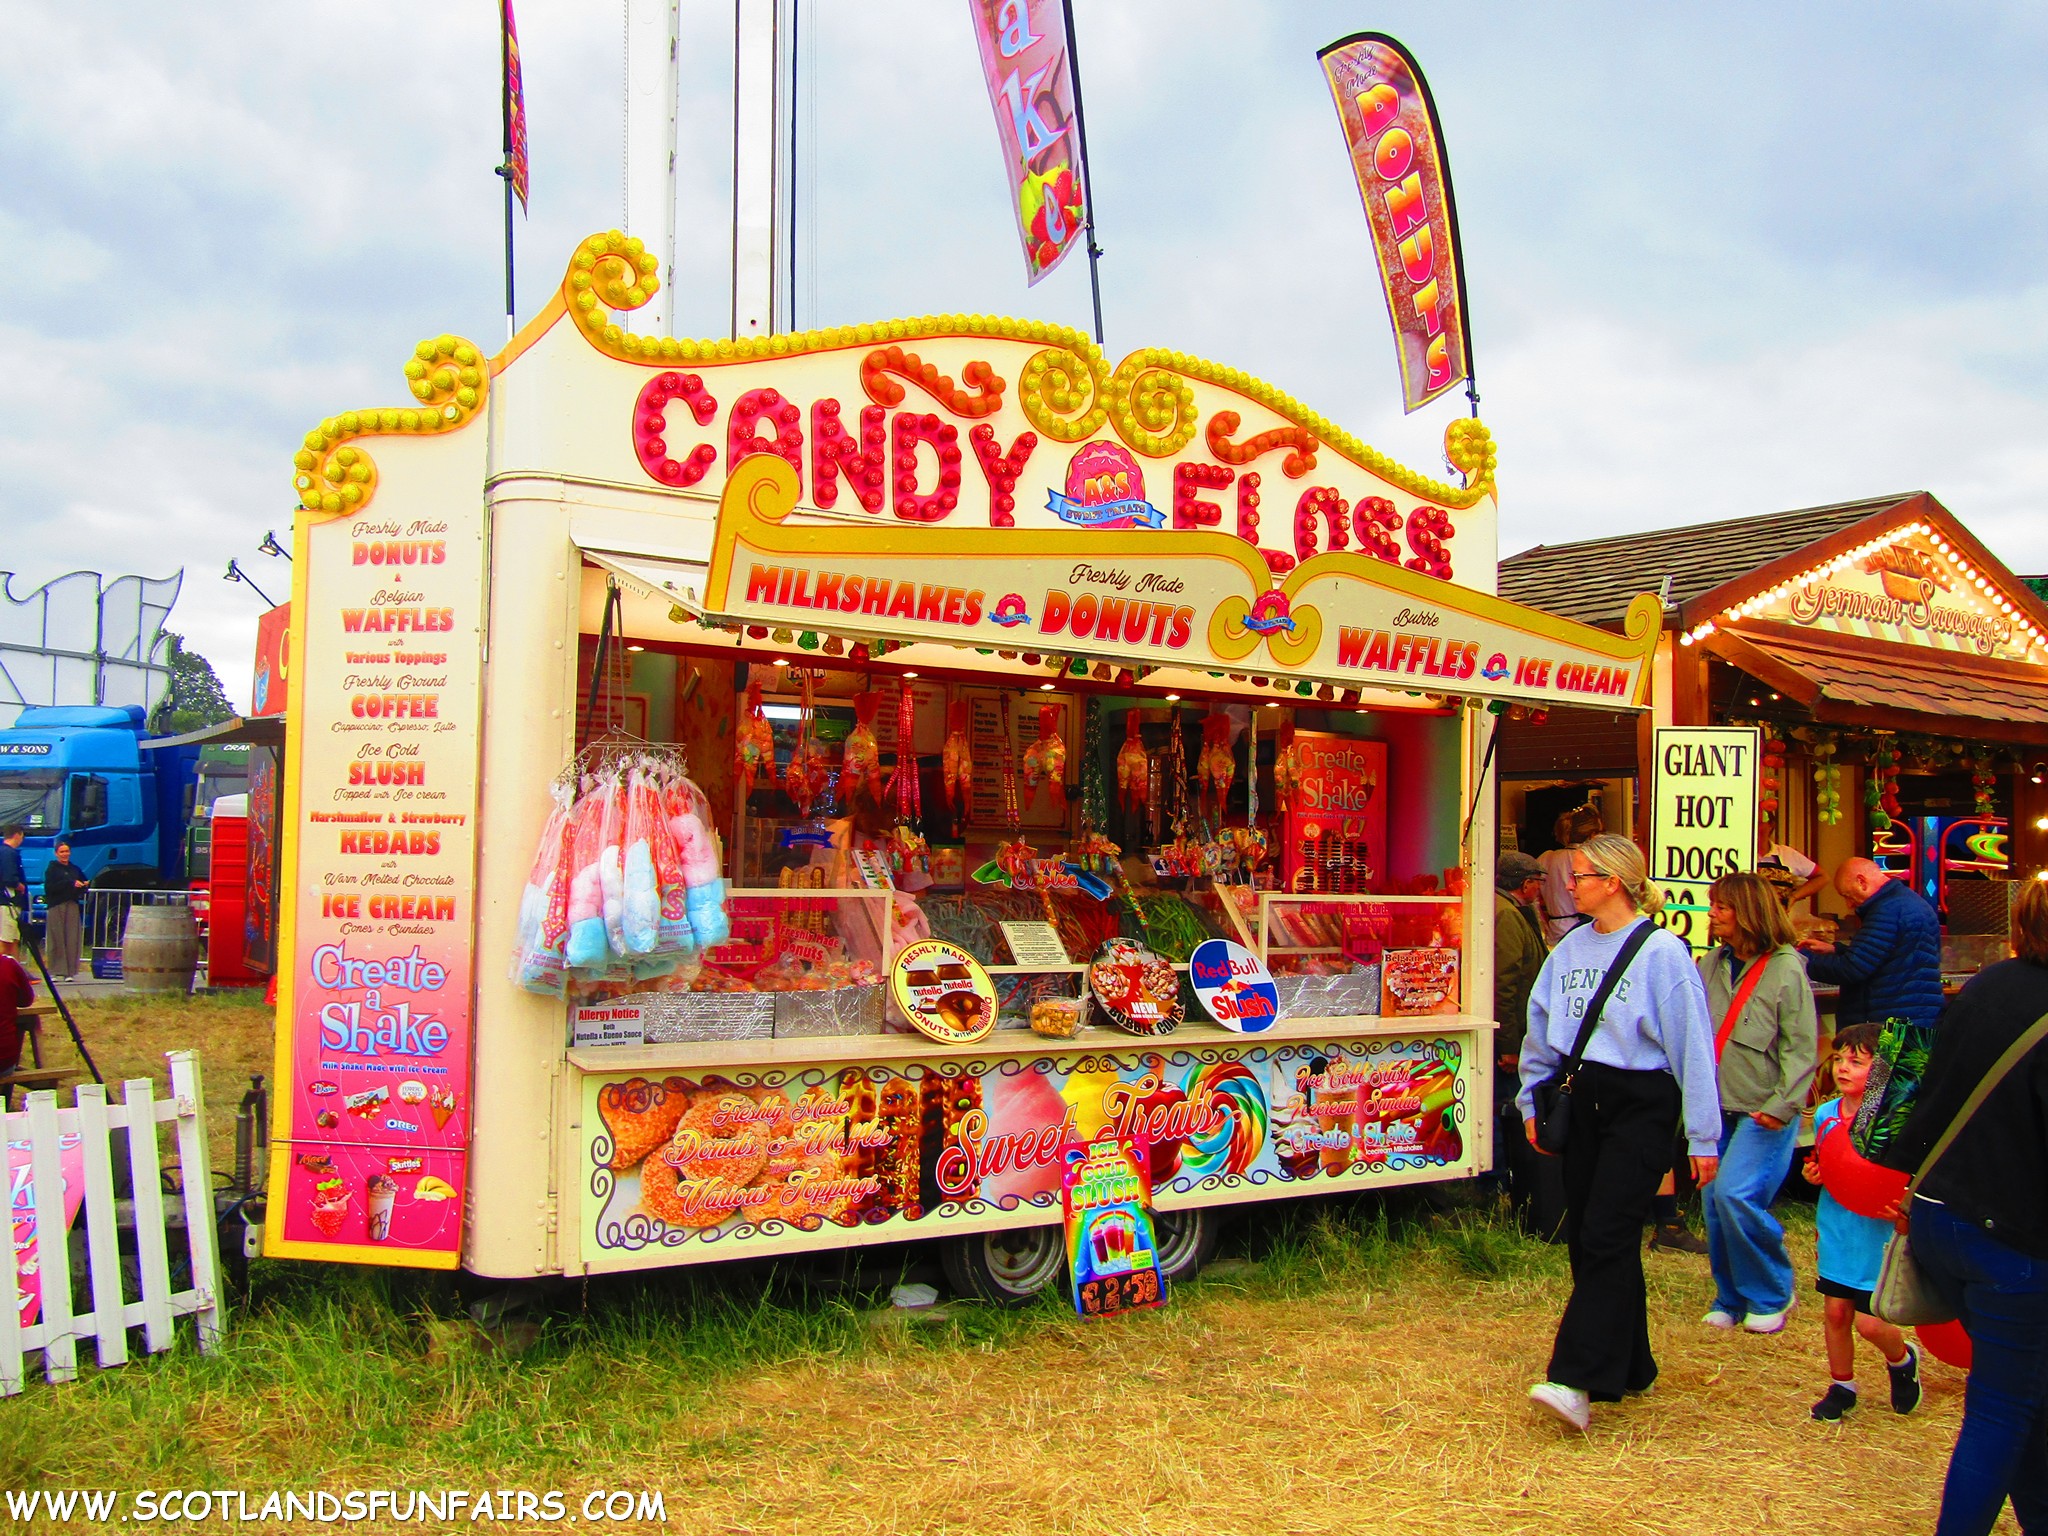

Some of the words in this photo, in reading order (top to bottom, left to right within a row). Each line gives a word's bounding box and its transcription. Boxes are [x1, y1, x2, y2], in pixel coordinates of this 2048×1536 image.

[1333, 45, 1375, 83] Freshly
[1345, 64, 1378, 99] Made
[1353, 82, 1452, 392] DONUTS
[632, 370, 1038, 527] CANDY
[1172, 461, 1456, 581] FLOSS
[1083, 472, 1133, 507] A&S
[1066, 504, 1104, 521] SWEET
[1105, 502, 1147, 518] TREATS
[352, 521, 401, 538] Freshly
[406, 520, 448, 536] Made
[351, 540, 446, 566] DONUTS
[394, 573, 402, 583] &
[1069, 563, 1133, 593] Freshly
[1134, 566, 1185, 595] Made
[370, 590, 425, 606] Belgian
[745, 562, 986, 627] MILKSHAKES
[341, 606, 455, 633] WAFFLES
[1037, 588, 1197, 650] DONUTS
[1392, 607, 1440, 628] Bubble
[1790, 578, 1903, 625] German
[1907, 578, 2012, 655] Sausages
[388, 638, 404, 648] with
[345, 650, 391, 664] Various
[393, 650, 447, 666] Toppings
[1337, 625, 1482, 680] WAFFLES
[1513, 655, 1551, 688] ICE
[1555, 660, 1630, 697] CREAM
[343, 674, 393, 691] Freshly
[397, 674, 448, 689] Ground
[351, 693, 440, 719] COFFEE
[433, 721, 457, 733] Latte
[10, 746, 20, 754] &
[21, 745, 50, 754] SONS
[357, 743, 382, 759] Ice
[386, 743, 420, 758] Cold
[1298, 742, 1367, 777] Create
[1664, 744, 1748, 777] GIANT
[348, 760, 425, 786] SLUSH
[1326, 769, 1334, 783] a
[333, 788, 371, 801] Topped
[372, 790, 390, 800] with
[393, 788, 413, 801] Ice
[416, 790, 447, 800] cream
[1303, 777, 1367, 811] Shake
[309, 811, 383, 824] Marshmallow
[388, 811, 396, 823] &
[400, 812, 467, 826] Strawberry
[1675, 795, 1734, 828] HOT
[340, 829, 442, 855] KEBABS
[380, 859, 398, 869] with
[1666, 846, 1740, 880] DOGS
[323, 872, 362, 887] Warm
[363, 871, 400, 886] Melted
[402, 873, 455, 887] Chocolate
[321, 893, 363, 920] ICE
[368, 894, 456, 921] CREAM
[339, 922, 374, 935] Cones
[388, 923, 436, 937] Sundaes
[780, 925, 814, 940] Freshly
[816, 933, 839, 948] Made
[780, 939, 824, 961] Donuts
[901, 945, 937, 970] FRESHLY
[941, 946, 973, 967] MADE
[1385, 954, 1420, 963] Belgian
[1424, 954, 1457, 962] Waffles
[311, 940, 452, 994] Create
[1194, 959, 1230, 979] Red
[1227, 957, 1259, 975] Bull
[913, 986, 943, 997] nutella
[944, 980, 973, 990] nutella
[1560, 968, 1631, 1003] VENE
[365, 989, 382, 1012] a
[1131, 1002, 1159, 1014] NEW
[1211, 991, 1276, 1021] Slush
[578, 1009, 610, 1021] Allergy
[612, 1008, 640, 1019] Notice
[908, 1003, 951, 1037] DONUTS
[971, 996, 993, 1034] nutella
[1109, 1006, 1156, 1037] BUBBLE
[319, 1001, 454, 1059] Shake
[576, 1032, 598, 1040] Nutella
[603, 1031, 622, 1039] Bueno
[623, 1030, 642, 1038] Sauce
[322, 1062, 339, 1070] Milk
[341, 1062, 364, 1071] Shake
[366, 1063, 387, 1072] Made
[389, 1064, 406, 1073] with
[408, 1065, 420, 1074] Ice
[422, 1065, 448, 1075] Cream
[1295, 1065, 1325, 1092] Ice
[1326, 1059, 1370, 1089] Cold
[1369, 1058, 1414, 1088] Slush
[713, 1095, 784, 1127] Freshly
[790, 1091, 850, 1121] Made
[1287, 1093, 1359, 1119] Icecream
[1363, 1087, 1421, 1116] Sundae
[386, 1119, 418, 1132] OREO
[935, 1102, 1080, 1195] Sweet
[1093, 1072, 1224, 1145] Treats
[1351, 1123, 1361, 1138] a
[663, 1129, 759, 1167] Donuts
[766, 1137, 797, 1155] &
[800, 1120, 893, 1157] Waffles
[1089, 1140, 1119, 1159] ICE
[1365, 1147, 1393, 1156] Icecream
[1393, 1144, 1424, 1153] Milkshakes
[391, 1159, 422, 1171] Skittles
[1081, 1160, 1128, 1183] COLD
[676, 1178, 772, 1217] Various
[780, 1168, 882, 1206] Toppings
[1071, 1176, 1140, 1211] SLUSH
